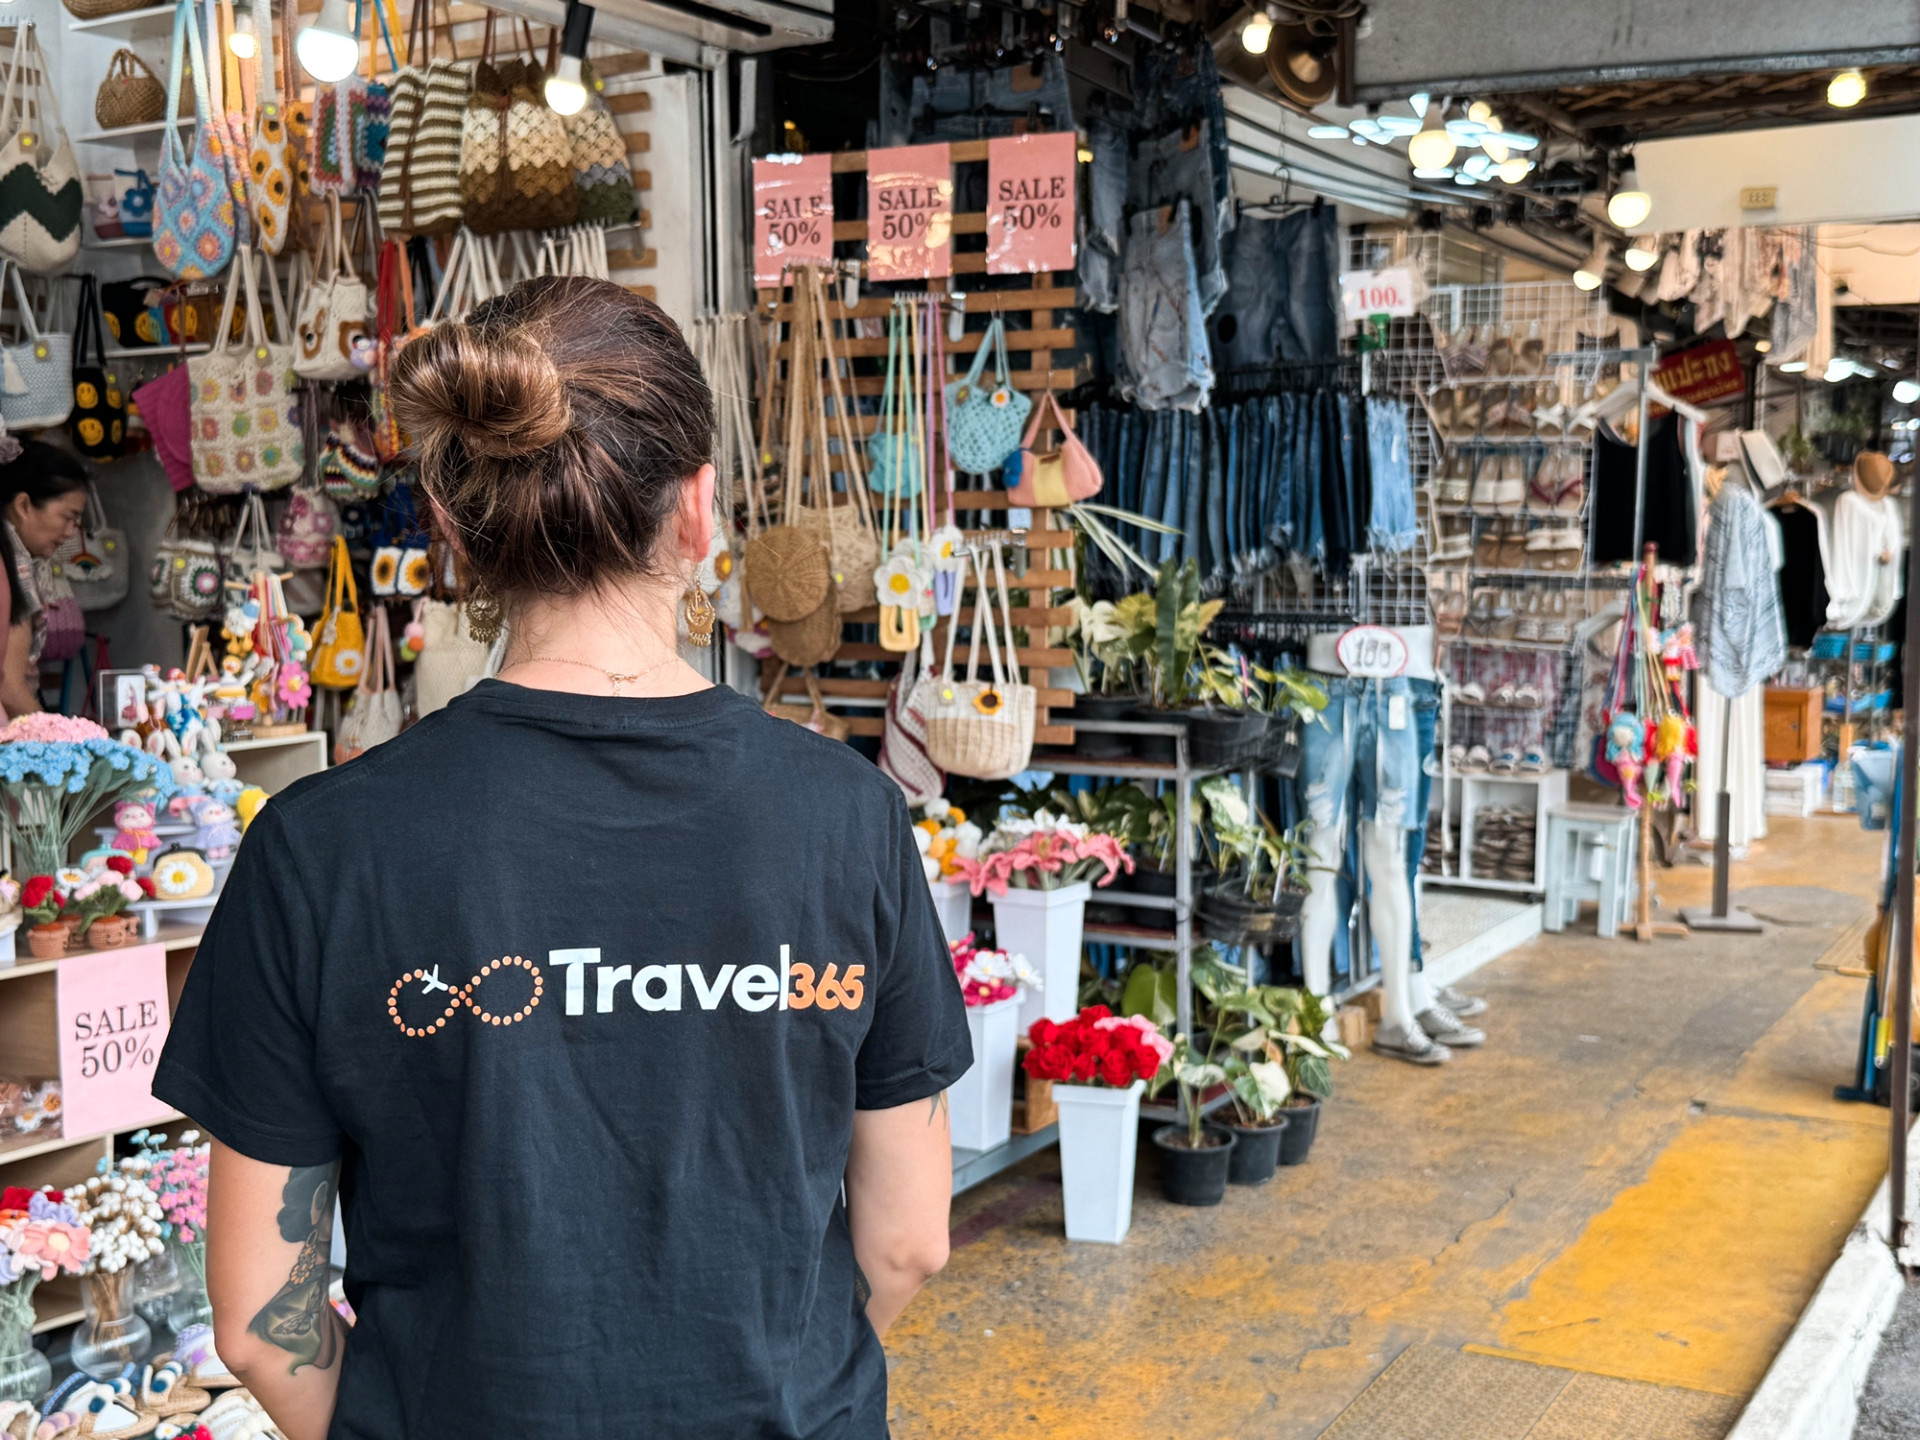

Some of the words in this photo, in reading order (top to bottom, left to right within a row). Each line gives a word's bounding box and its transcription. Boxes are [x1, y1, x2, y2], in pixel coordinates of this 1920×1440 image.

[879, 187, 942, 211] SALE
[999, 177, 1066, 202] SALE
[764, 196, 824, 219] SALE
[1002, 203, 1061, 231] 50%
[75, 1000, 158, 1041] SALE
[82, 1033, 154, 1078] 50%
